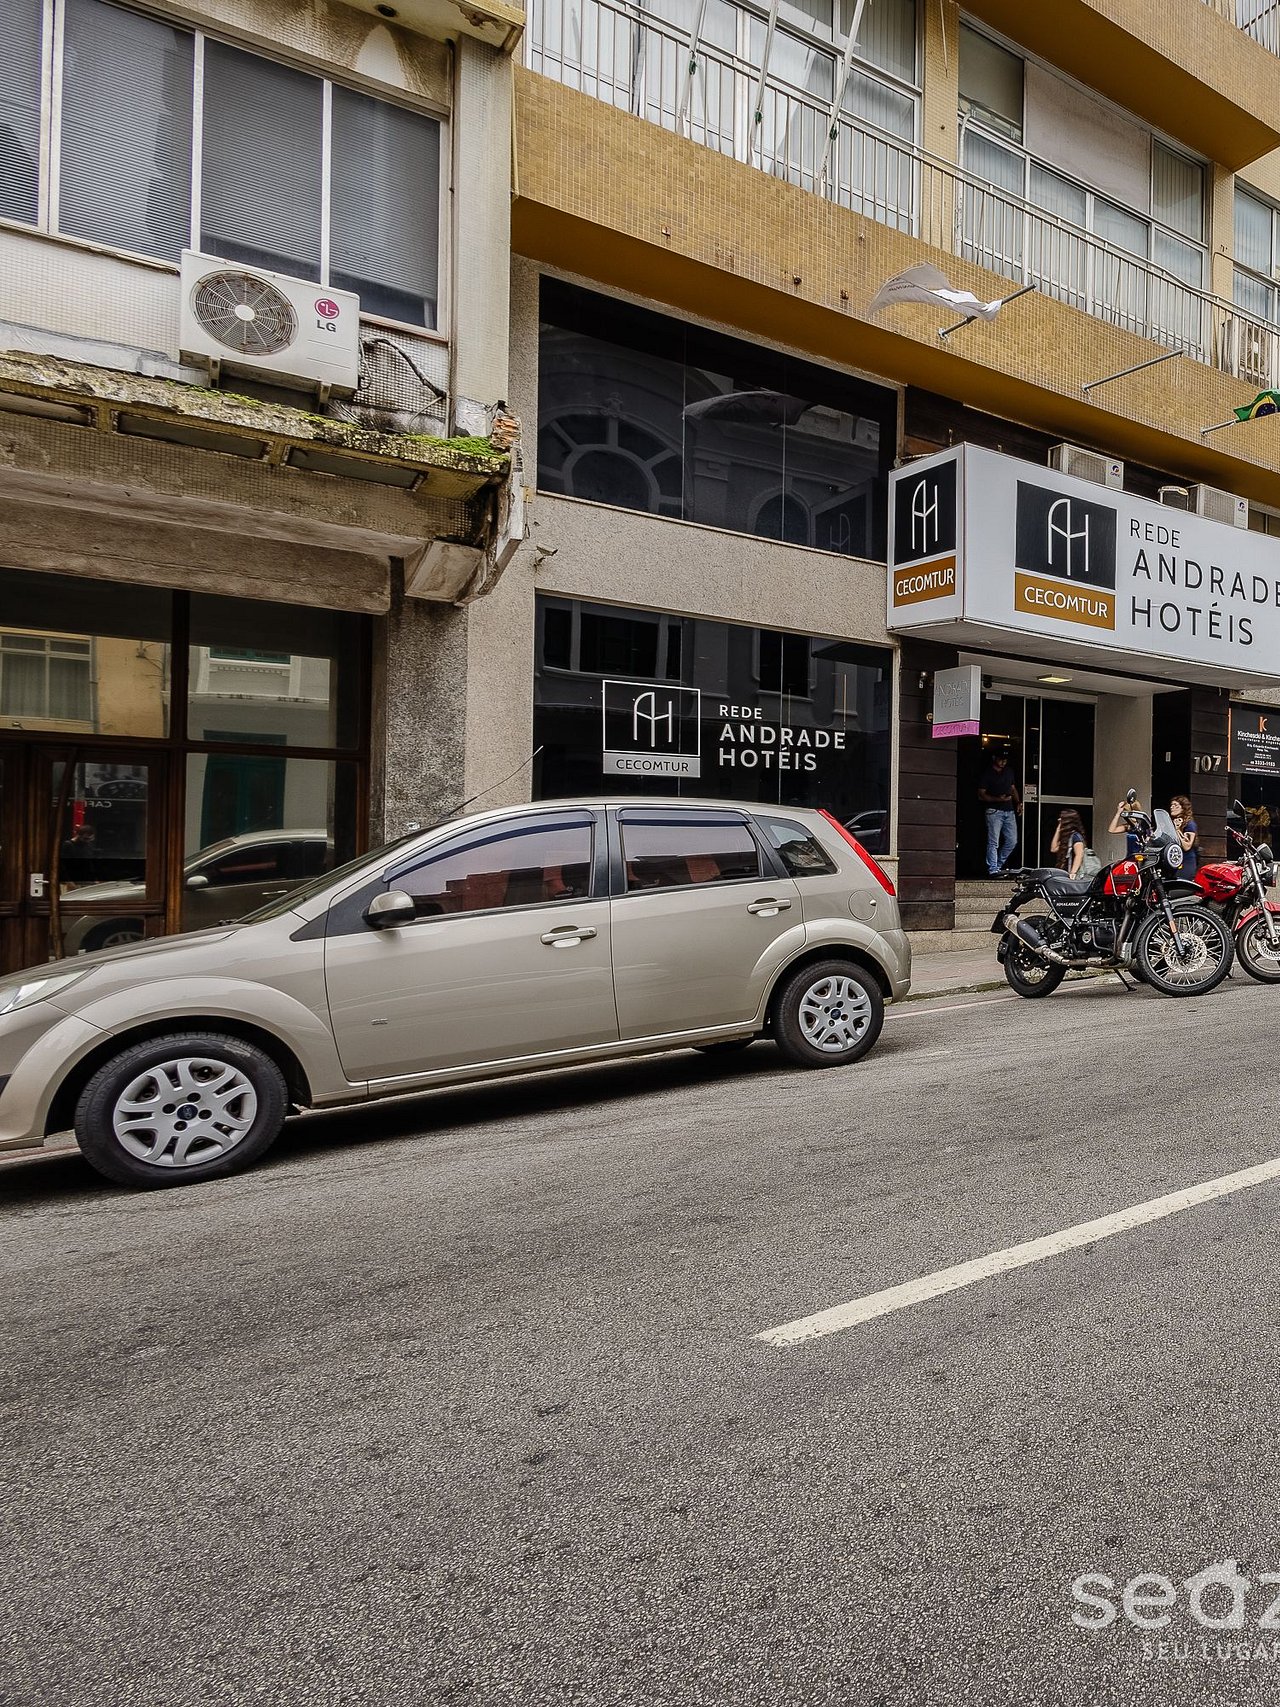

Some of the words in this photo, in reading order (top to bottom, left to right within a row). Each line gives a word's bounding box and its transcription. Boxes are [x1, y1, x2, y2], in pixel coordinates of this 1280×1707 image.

[317, 319, 336, 333] LG
[1130, 518, 1181, 549] REDE
[896, 568, 954, 597] CECOMTUR
[1024, 586, 1108, 619] CECOMTUR
[1131, 595, 1253, 646] HOTÉIS
[719, 704, 763, 720] REDE
[719, 723, 846, 749] ANDRADE
[615, 758, 689, 773] CECOMTUR
[719, 746, 818, 771] HOTÉIS
[1193, 754, 1222, 773] 107
